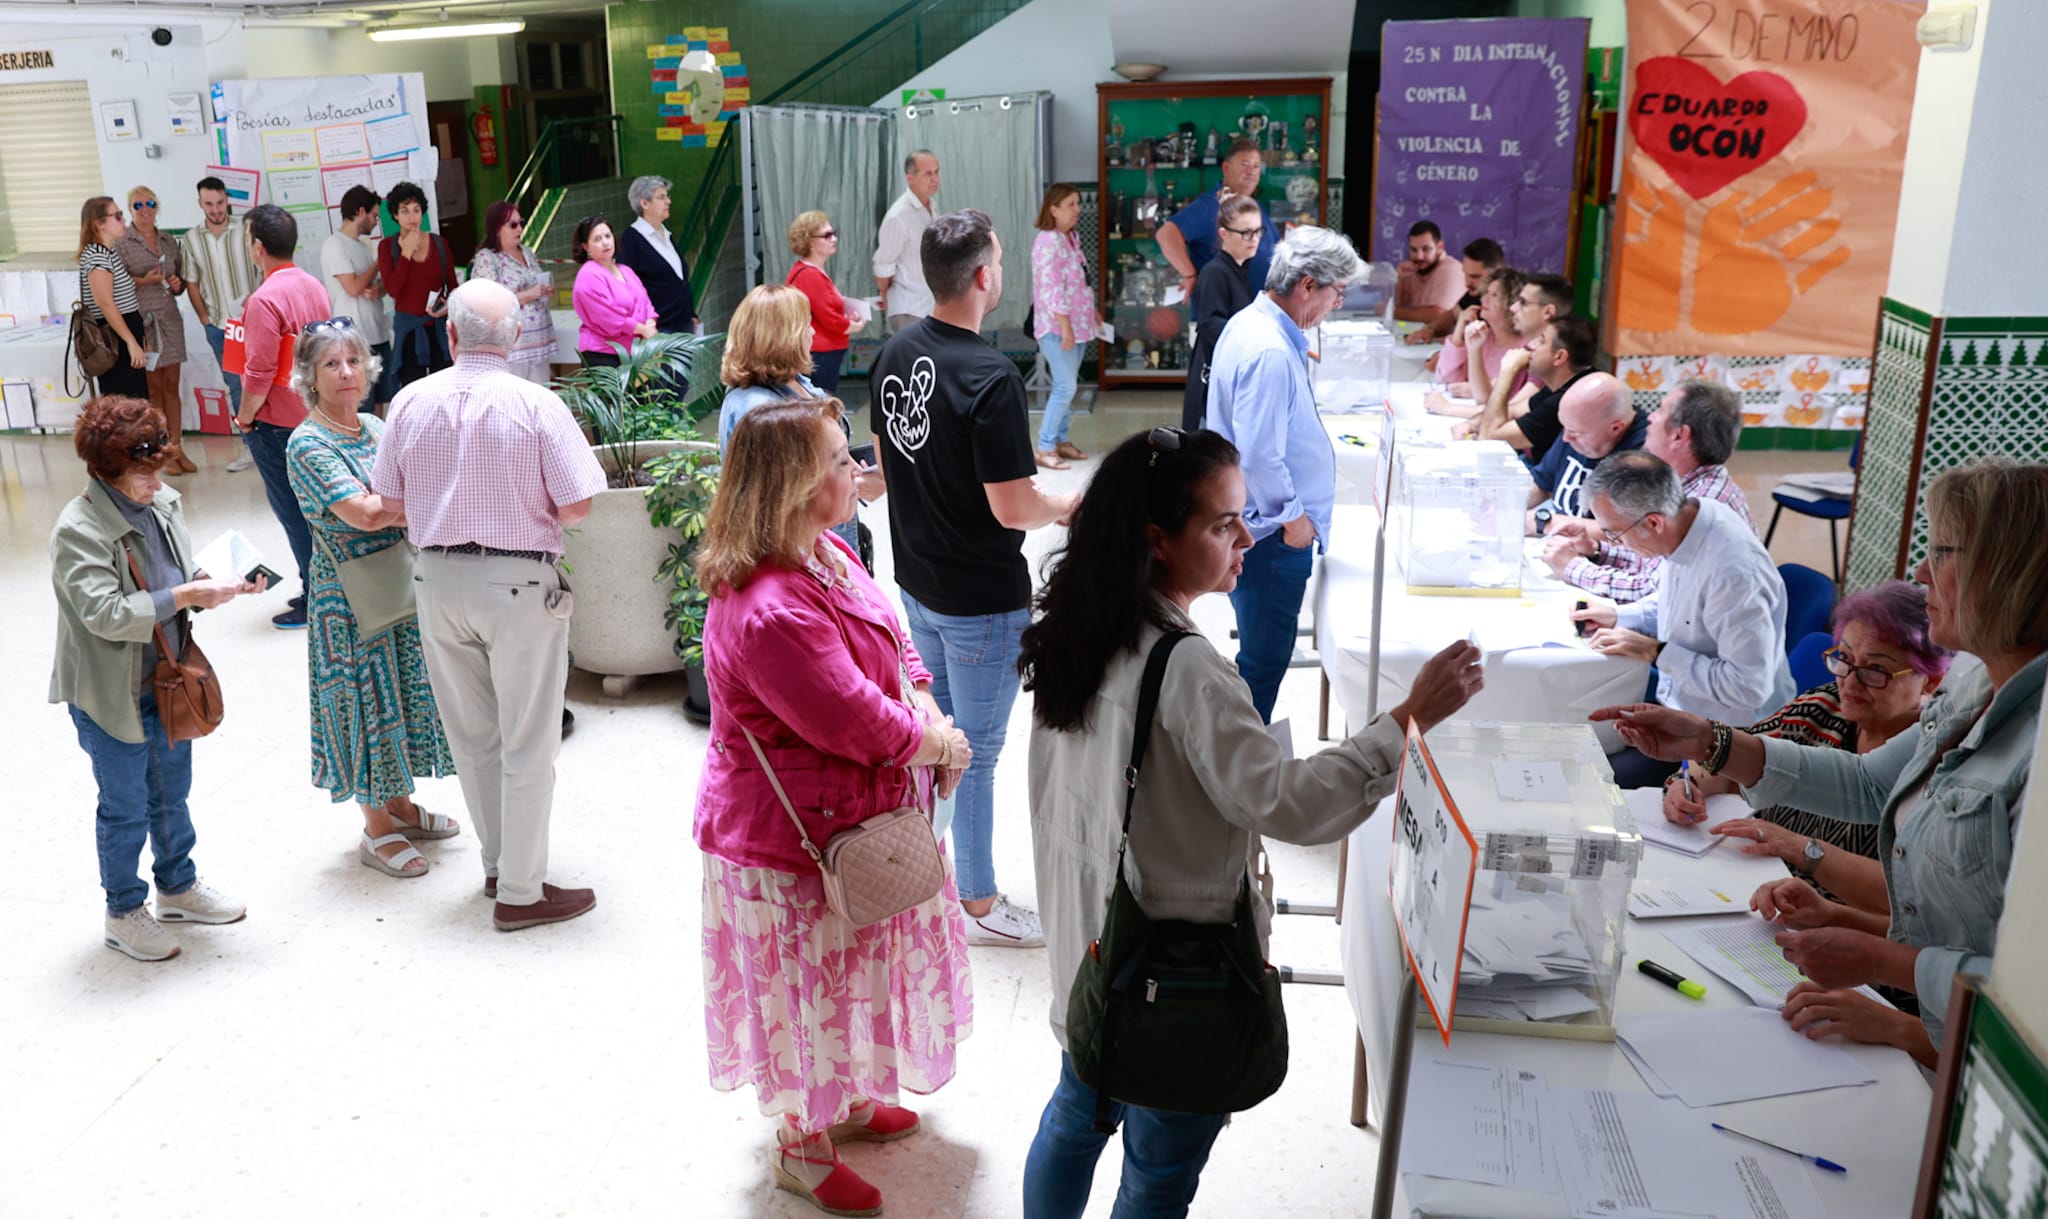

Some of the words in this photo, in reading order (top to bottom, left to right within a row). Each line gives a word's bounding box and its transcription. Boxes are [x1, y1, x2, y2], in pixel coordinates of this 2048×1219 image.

[1676, 3, 1724, 58] 2
[1731, 9, 1780, 62] DE
[1783, 13, 1859, 63] MAYO
[1403, 46, 1426, 63] 25
[1430, 47, 1441, 63] N
[1453, 45, 1484, 62] DIA
[1487, 43, 1571, 147] INTERNACIONAL
[1405, 86, 1467, 103] CONTRA
[1637, 93, 1768, 119] EDUARDO
[1470, 103, 1493, 121] LA
[1398, 137, 1484, 154] VIOLENCIA
[1500, 140, 1521, 156] DE
[1669, 118, 1764, 159] OCÓN
[1416, 161, 1479, 182] GÉNERO
